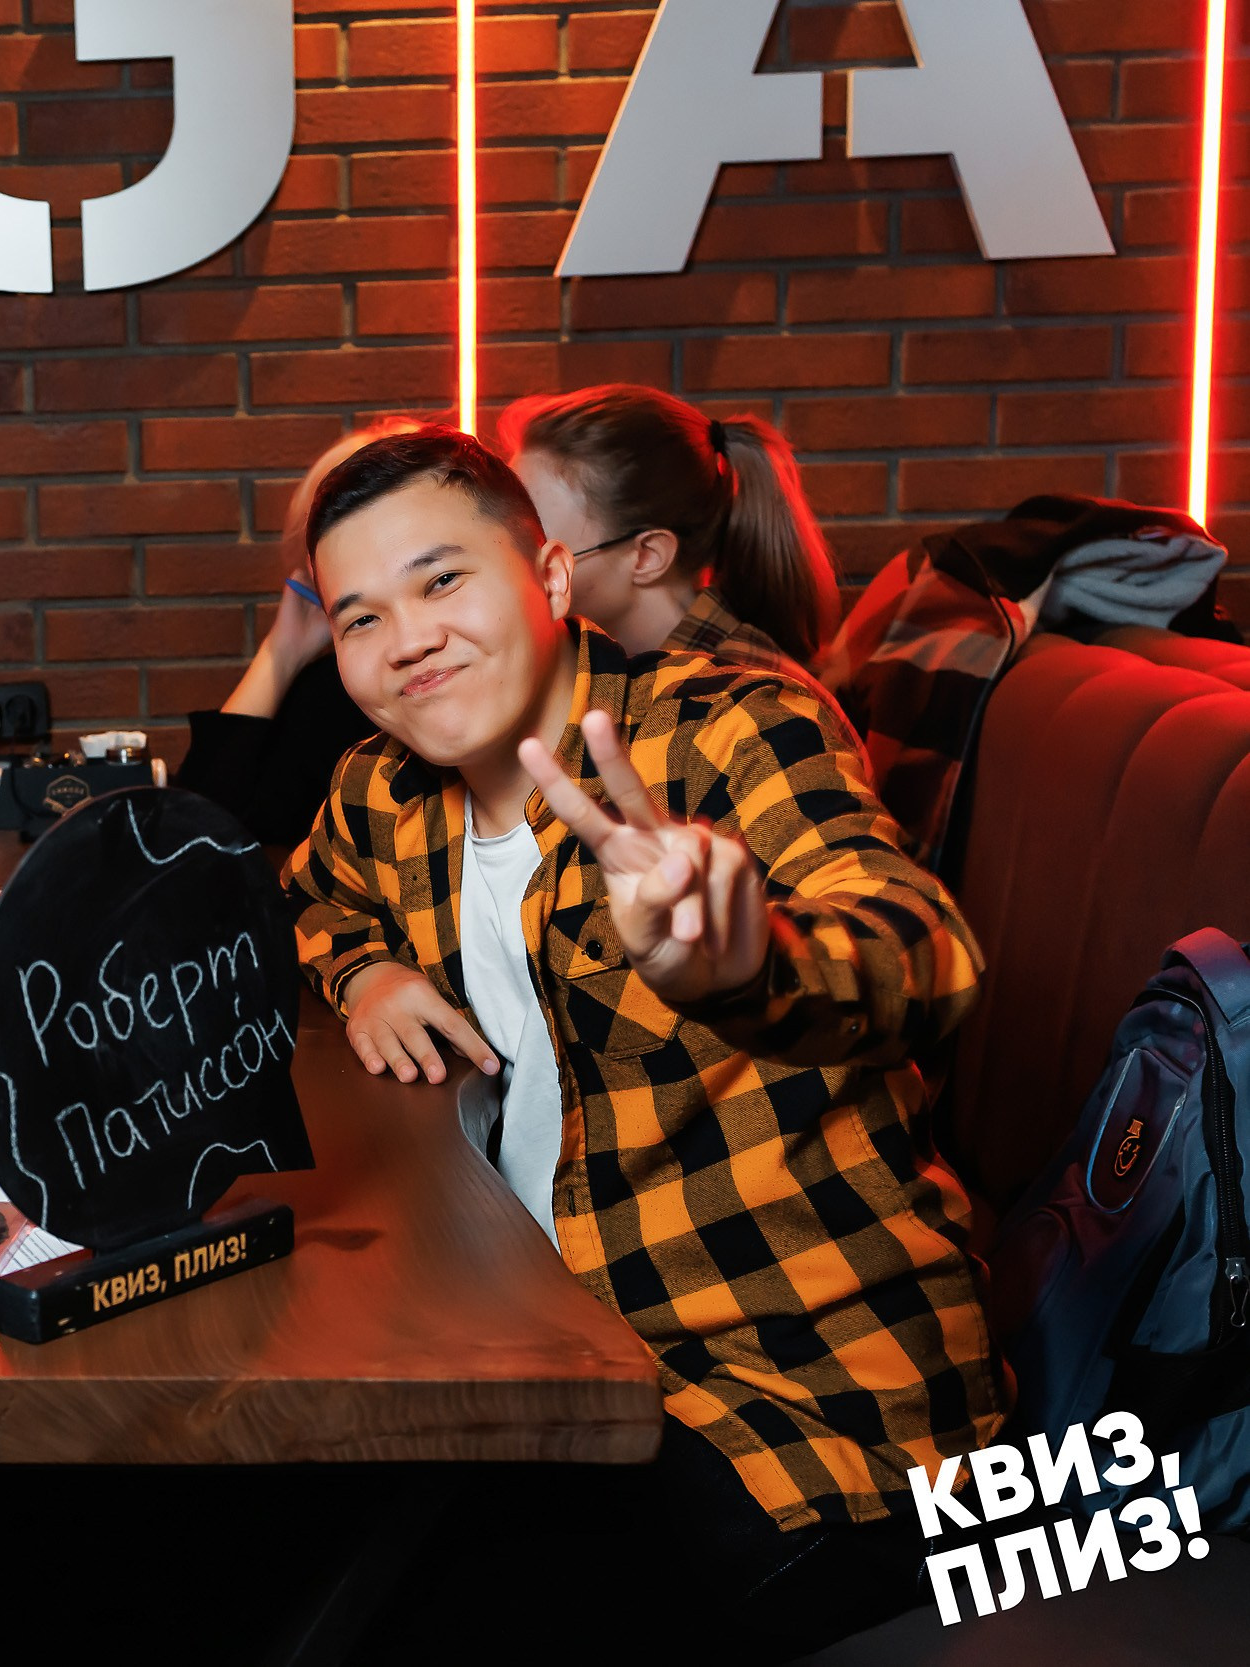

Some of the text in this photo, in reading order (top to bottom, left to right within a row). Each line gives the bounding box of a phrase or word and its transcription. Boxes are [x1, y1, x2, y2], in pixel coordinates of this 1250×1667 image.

[16, 931, 259, 1066] Роберт
[93, 1232, 247, 1312] КВИЗ, ПЛИЗ!
